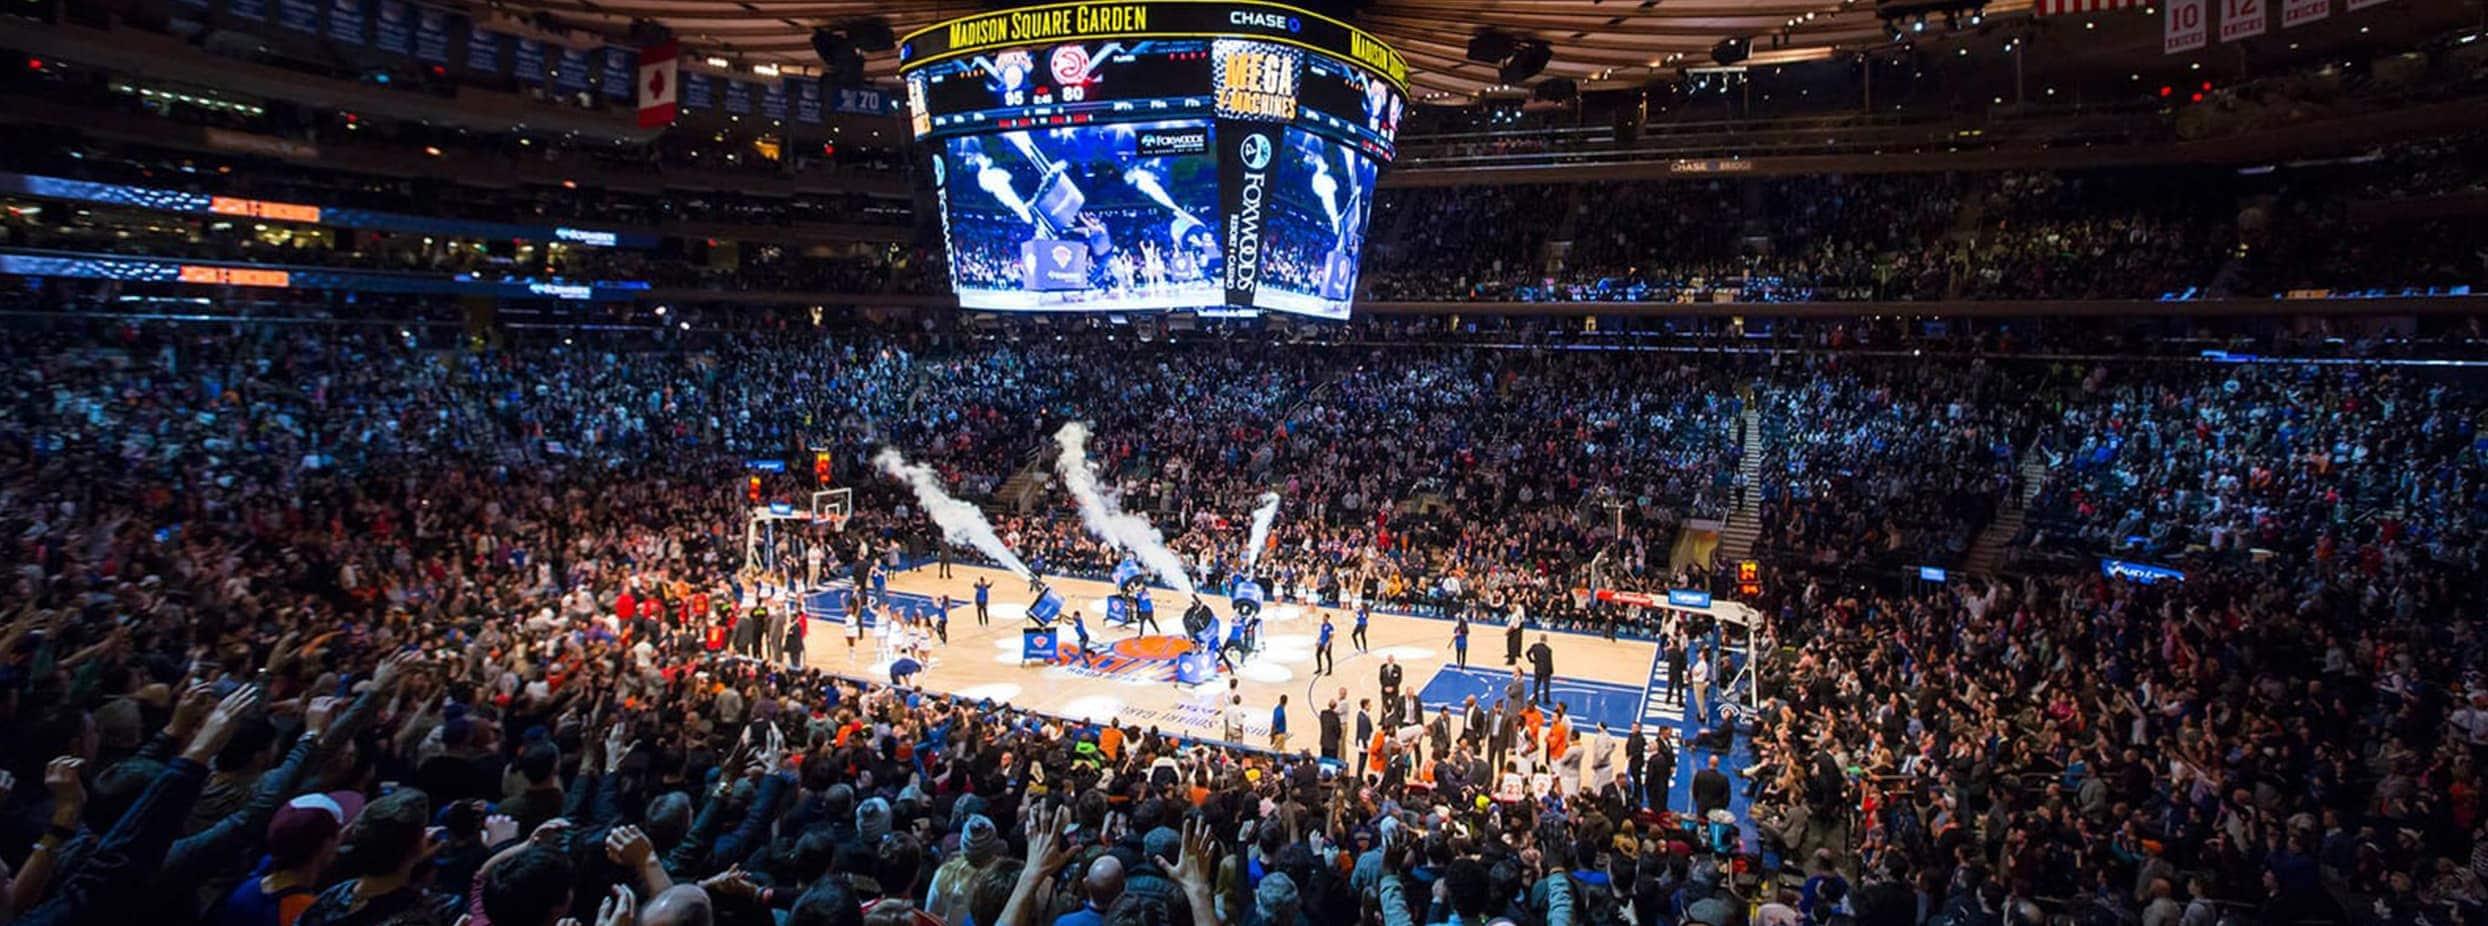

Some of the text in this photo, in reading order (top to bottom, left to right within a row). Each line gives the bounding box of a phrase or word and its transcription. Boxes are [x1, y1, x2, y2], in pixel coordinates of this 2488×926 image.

[1230, 11, 1286, 29] CHASE
[2171, 4, 2198, 32] 10
[2228, 0, 2257, 18] 12
[950, 6, 1147, 49] MADISON SQUARE GARDEN
[1225, 52, 1293, 96] MEGA
[860, 91, 879, 110] 70
[1004, 91, 1024, 107] 95
[1062, 86, 1084, 102] 80
[1231, 91, 1297, 120] MACHINES
[1237, 172, 1265, 292] FOXWOODS
